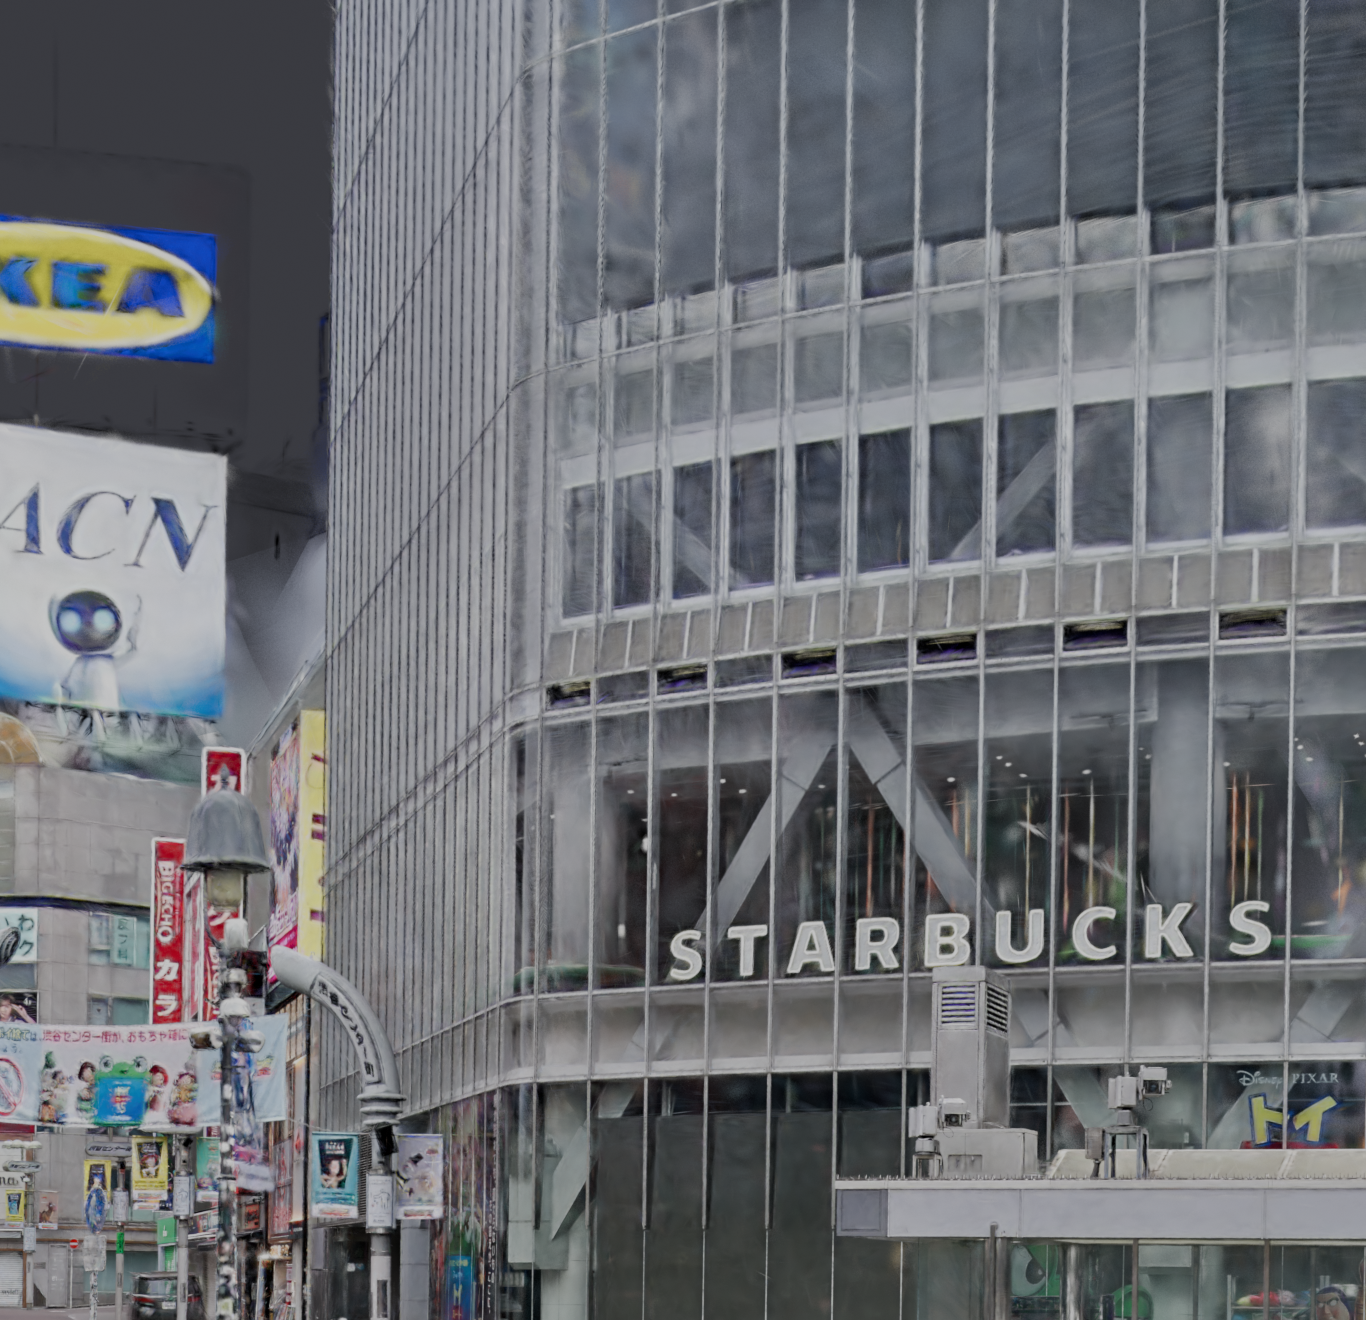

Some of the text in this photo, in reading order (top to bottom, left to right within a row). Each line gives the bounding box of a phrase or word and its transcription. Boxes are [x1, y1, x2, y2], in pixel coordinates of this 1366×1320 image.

[669, 900, 1273, 982] STARBUCKS
[1237, 1070, 1339, 1088] Disney PIXAR
